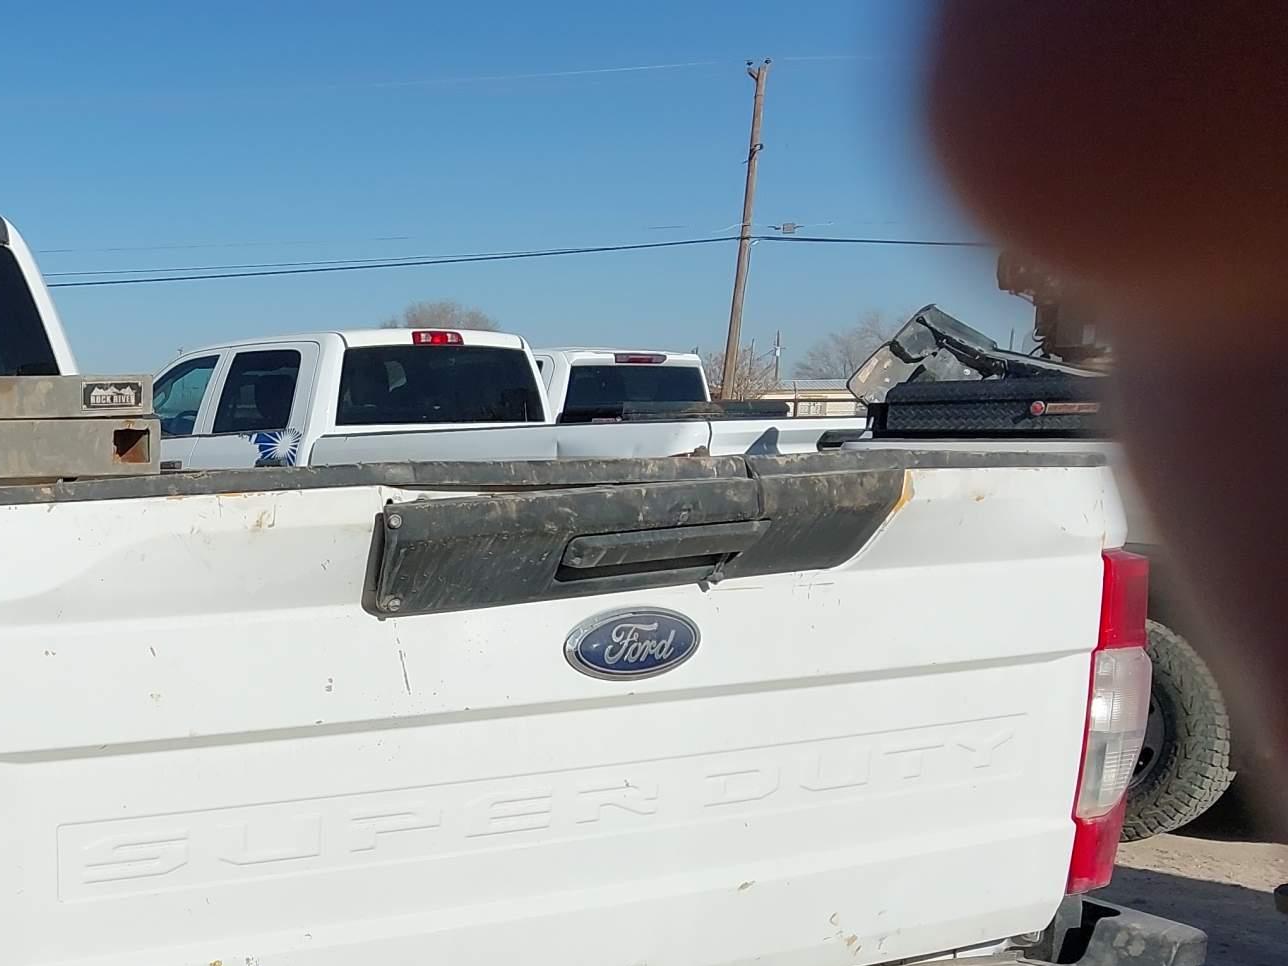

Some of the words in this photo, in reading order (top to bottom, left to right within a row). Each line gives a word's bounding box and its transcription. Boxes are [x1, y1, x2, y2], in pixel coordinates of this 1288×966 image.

[604, 622, 676, 665] Ford
[80, 778, 661, 884] SUPER
[702, 728, 1016, 808] DUTY
